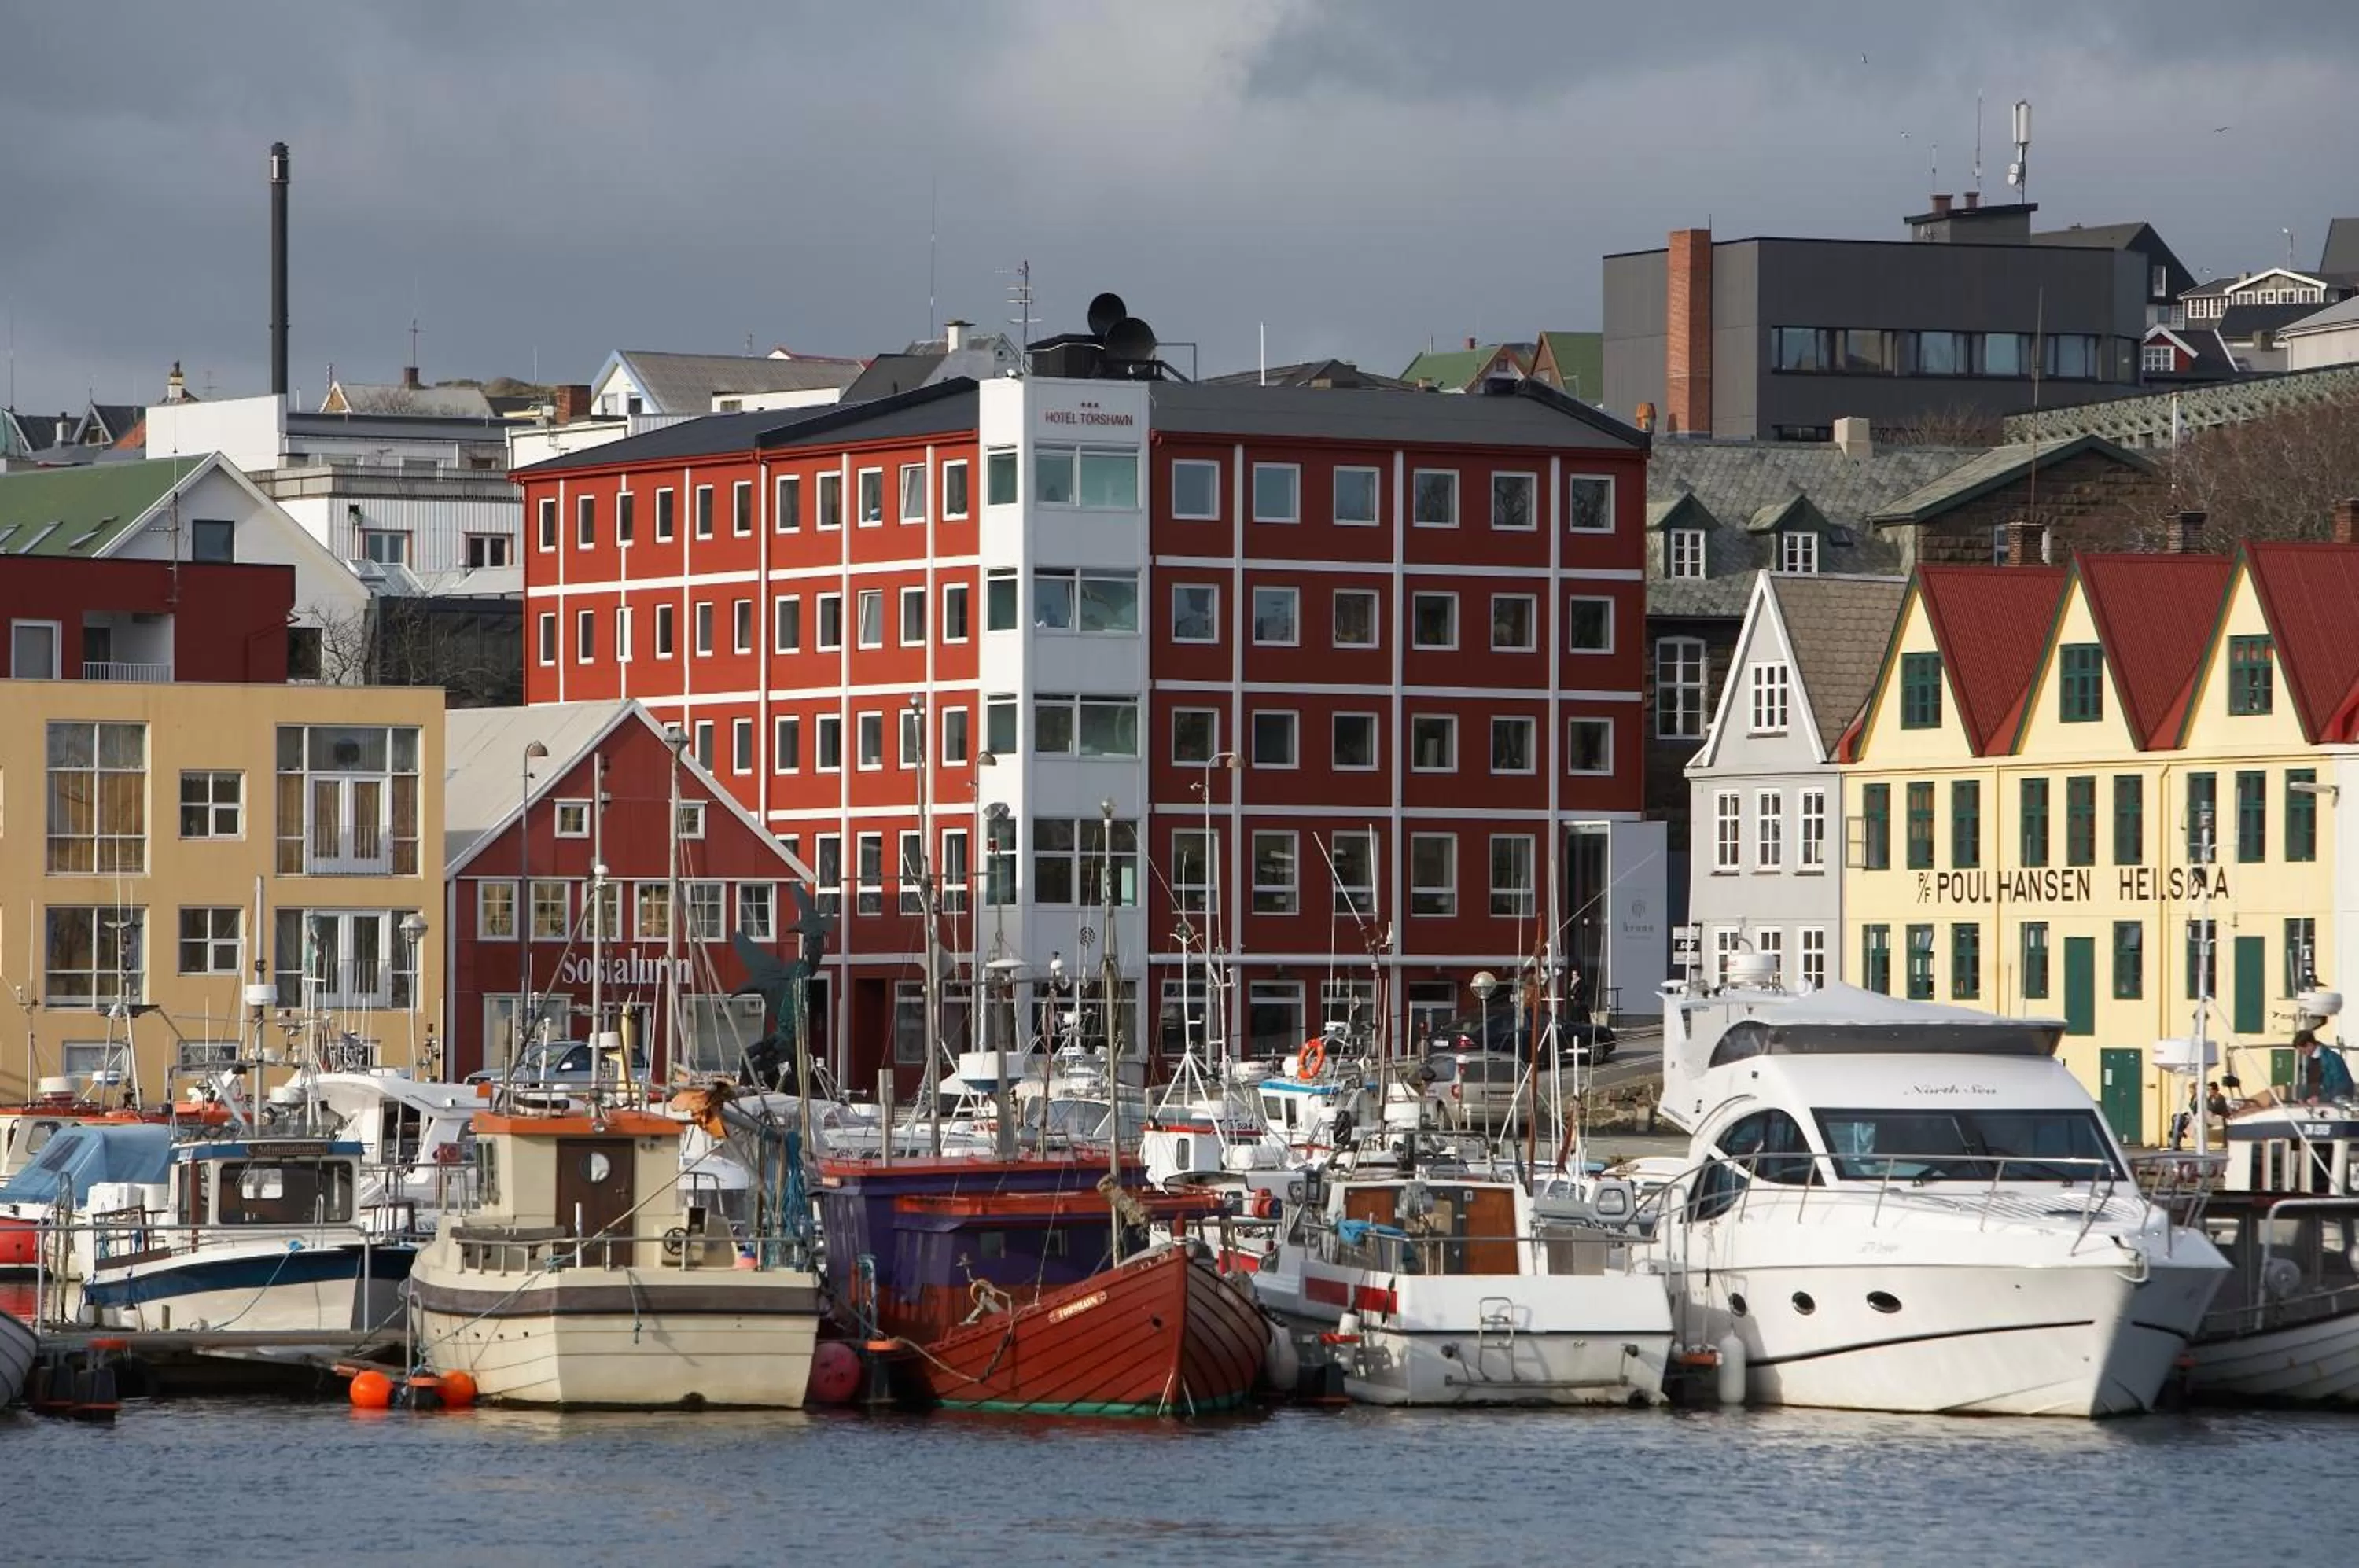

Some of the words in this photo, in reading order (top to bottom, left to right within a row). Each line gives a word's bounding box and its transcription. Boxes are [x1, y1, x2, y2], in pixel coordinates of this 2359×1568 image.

[1044, 411, 1078, 425] HOTEL
[1937, 871, 1992, 903] POUL
[1997, 869, 2090, 903] HANSEN
[562, 948, 691, 984] Sosialurn
[1902, 1084, 1959, 1095] North
[1963, 1084, 1997, 1094] Sea
